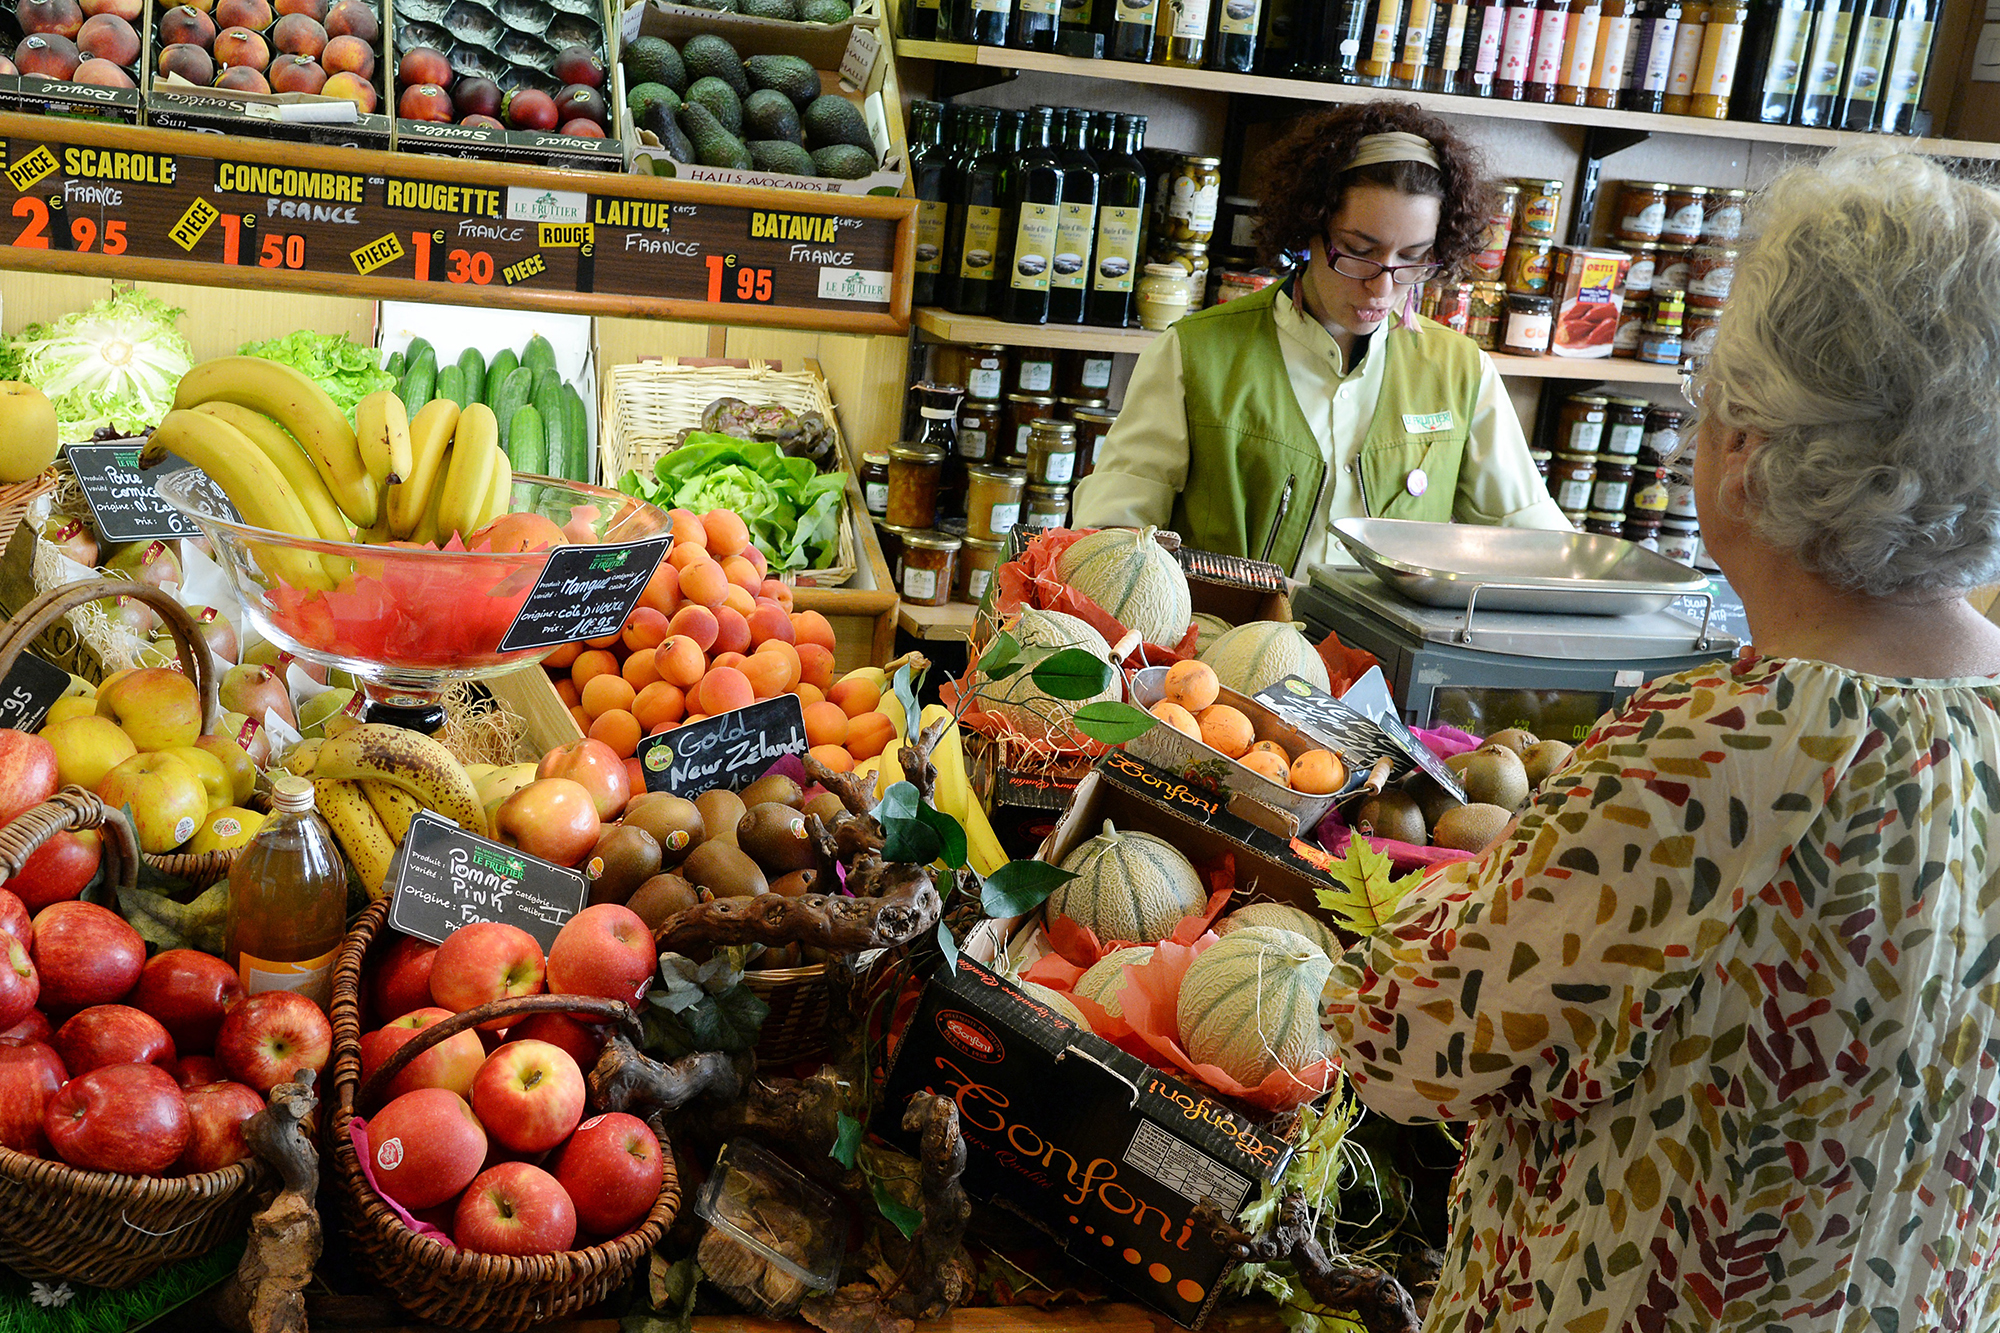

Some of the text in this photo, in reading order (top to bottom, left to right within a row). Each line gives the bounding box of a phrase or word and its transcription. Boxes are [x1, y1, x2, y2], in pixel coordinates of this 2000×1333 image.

[42, 83, 118, 101] Royal
[156, 114, 187, 127] Sun
[413, 125, 492, 141] Sevilla
[536, 136, 602, 151] Royal
[10, 151, 54, 187] PIECE
[65, 148, 173, 184] SCAROLE
[64, 180, 123, 206] FRANCE
[220, 163, 364, 202] CONCOMBRE
[747, 177, 822, 191] AVOCADOS
[387, 179, 500, 216] ROUGETTE
[266, 198, 360, 224] FRANCE
[515, 202, 578, 217] LE FRUITIER
[595, 199, 670, 229] LAITUE
[176, 202, 214, 245] PIECE
[458, 219, 524, 242] FRANCE
[752, 212, 835, 243] BATAVIA
[543, 227, 590, 244] ROUGE
[625, 232, 700, 257] FRANCE
[356, 238, 399, 270] PIECE
[789, 244, 855, 266] FRANCE
[503, 253, 546, 285] PIECE
[1587, 264, 1614, 272] ORTIZ
[826, 281, 837, 292] LE
[841, 283, 884, 295] FRUITIER
[1413, 413, 1451, 425] FRUITIER
[105, 466, 142, 485] Poire
[1686, 609, 1726, 621] ELSNTA
[678, 711, 756, 757] Gold
[671, 758, 723, 790] New
[472, 855, 484, 865] LE
[484, 859, 525, 881] FRUITIER
[1177, 1149, 1200, 1164] FRANCE
[1192, 1164, 1215, 1180] MELONS
